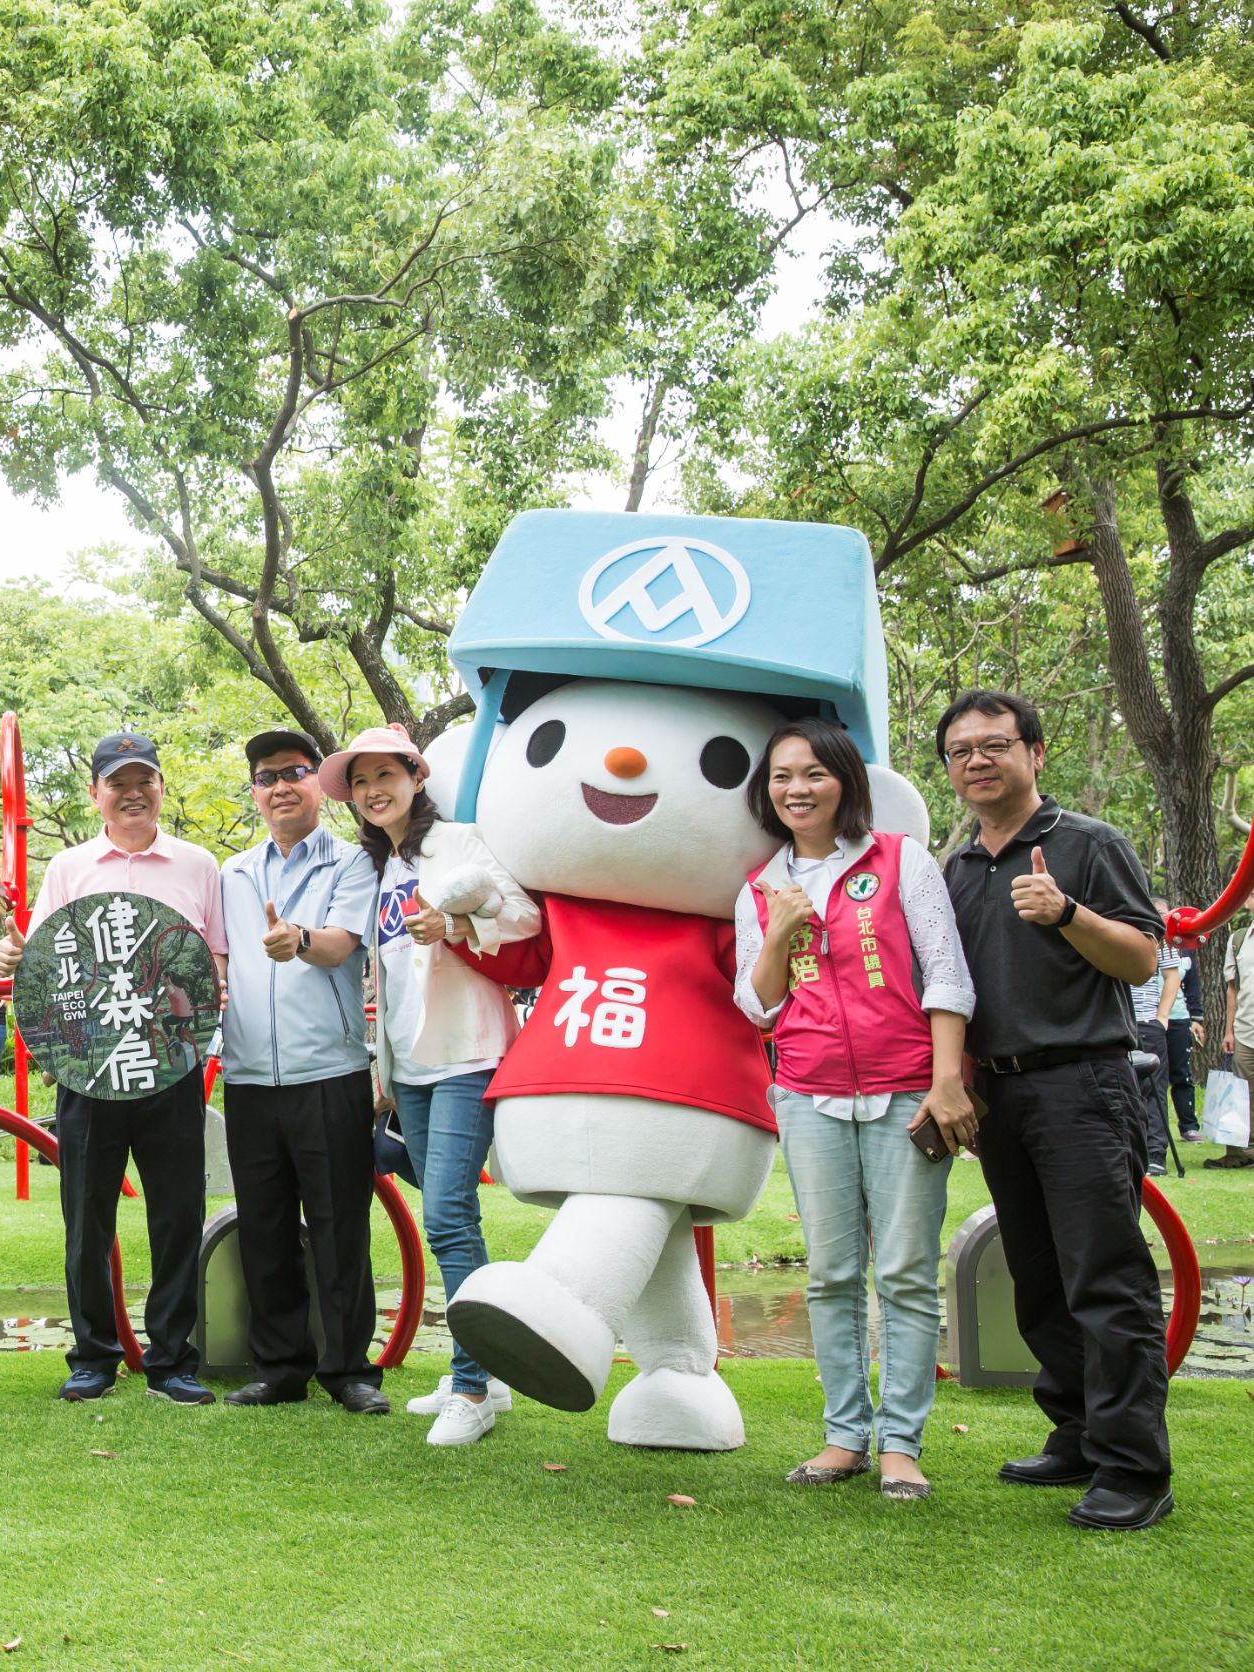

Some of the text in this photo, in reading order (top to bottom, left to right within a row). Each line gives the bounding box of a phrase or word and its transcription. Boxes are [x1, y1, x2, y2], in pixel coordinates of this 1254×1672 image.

[53, 921, 82, 990] 台北
[856, 906, 886, 989] 台北市議員
[51, 989, 84, 1003] TAIPEI
[62, 1000, 86, 1011] ECO
[63, 1010, 87, 1021] GYM
[85, 896, 159, 1093] 健森房
[553, 965, 647, 1049] 福
